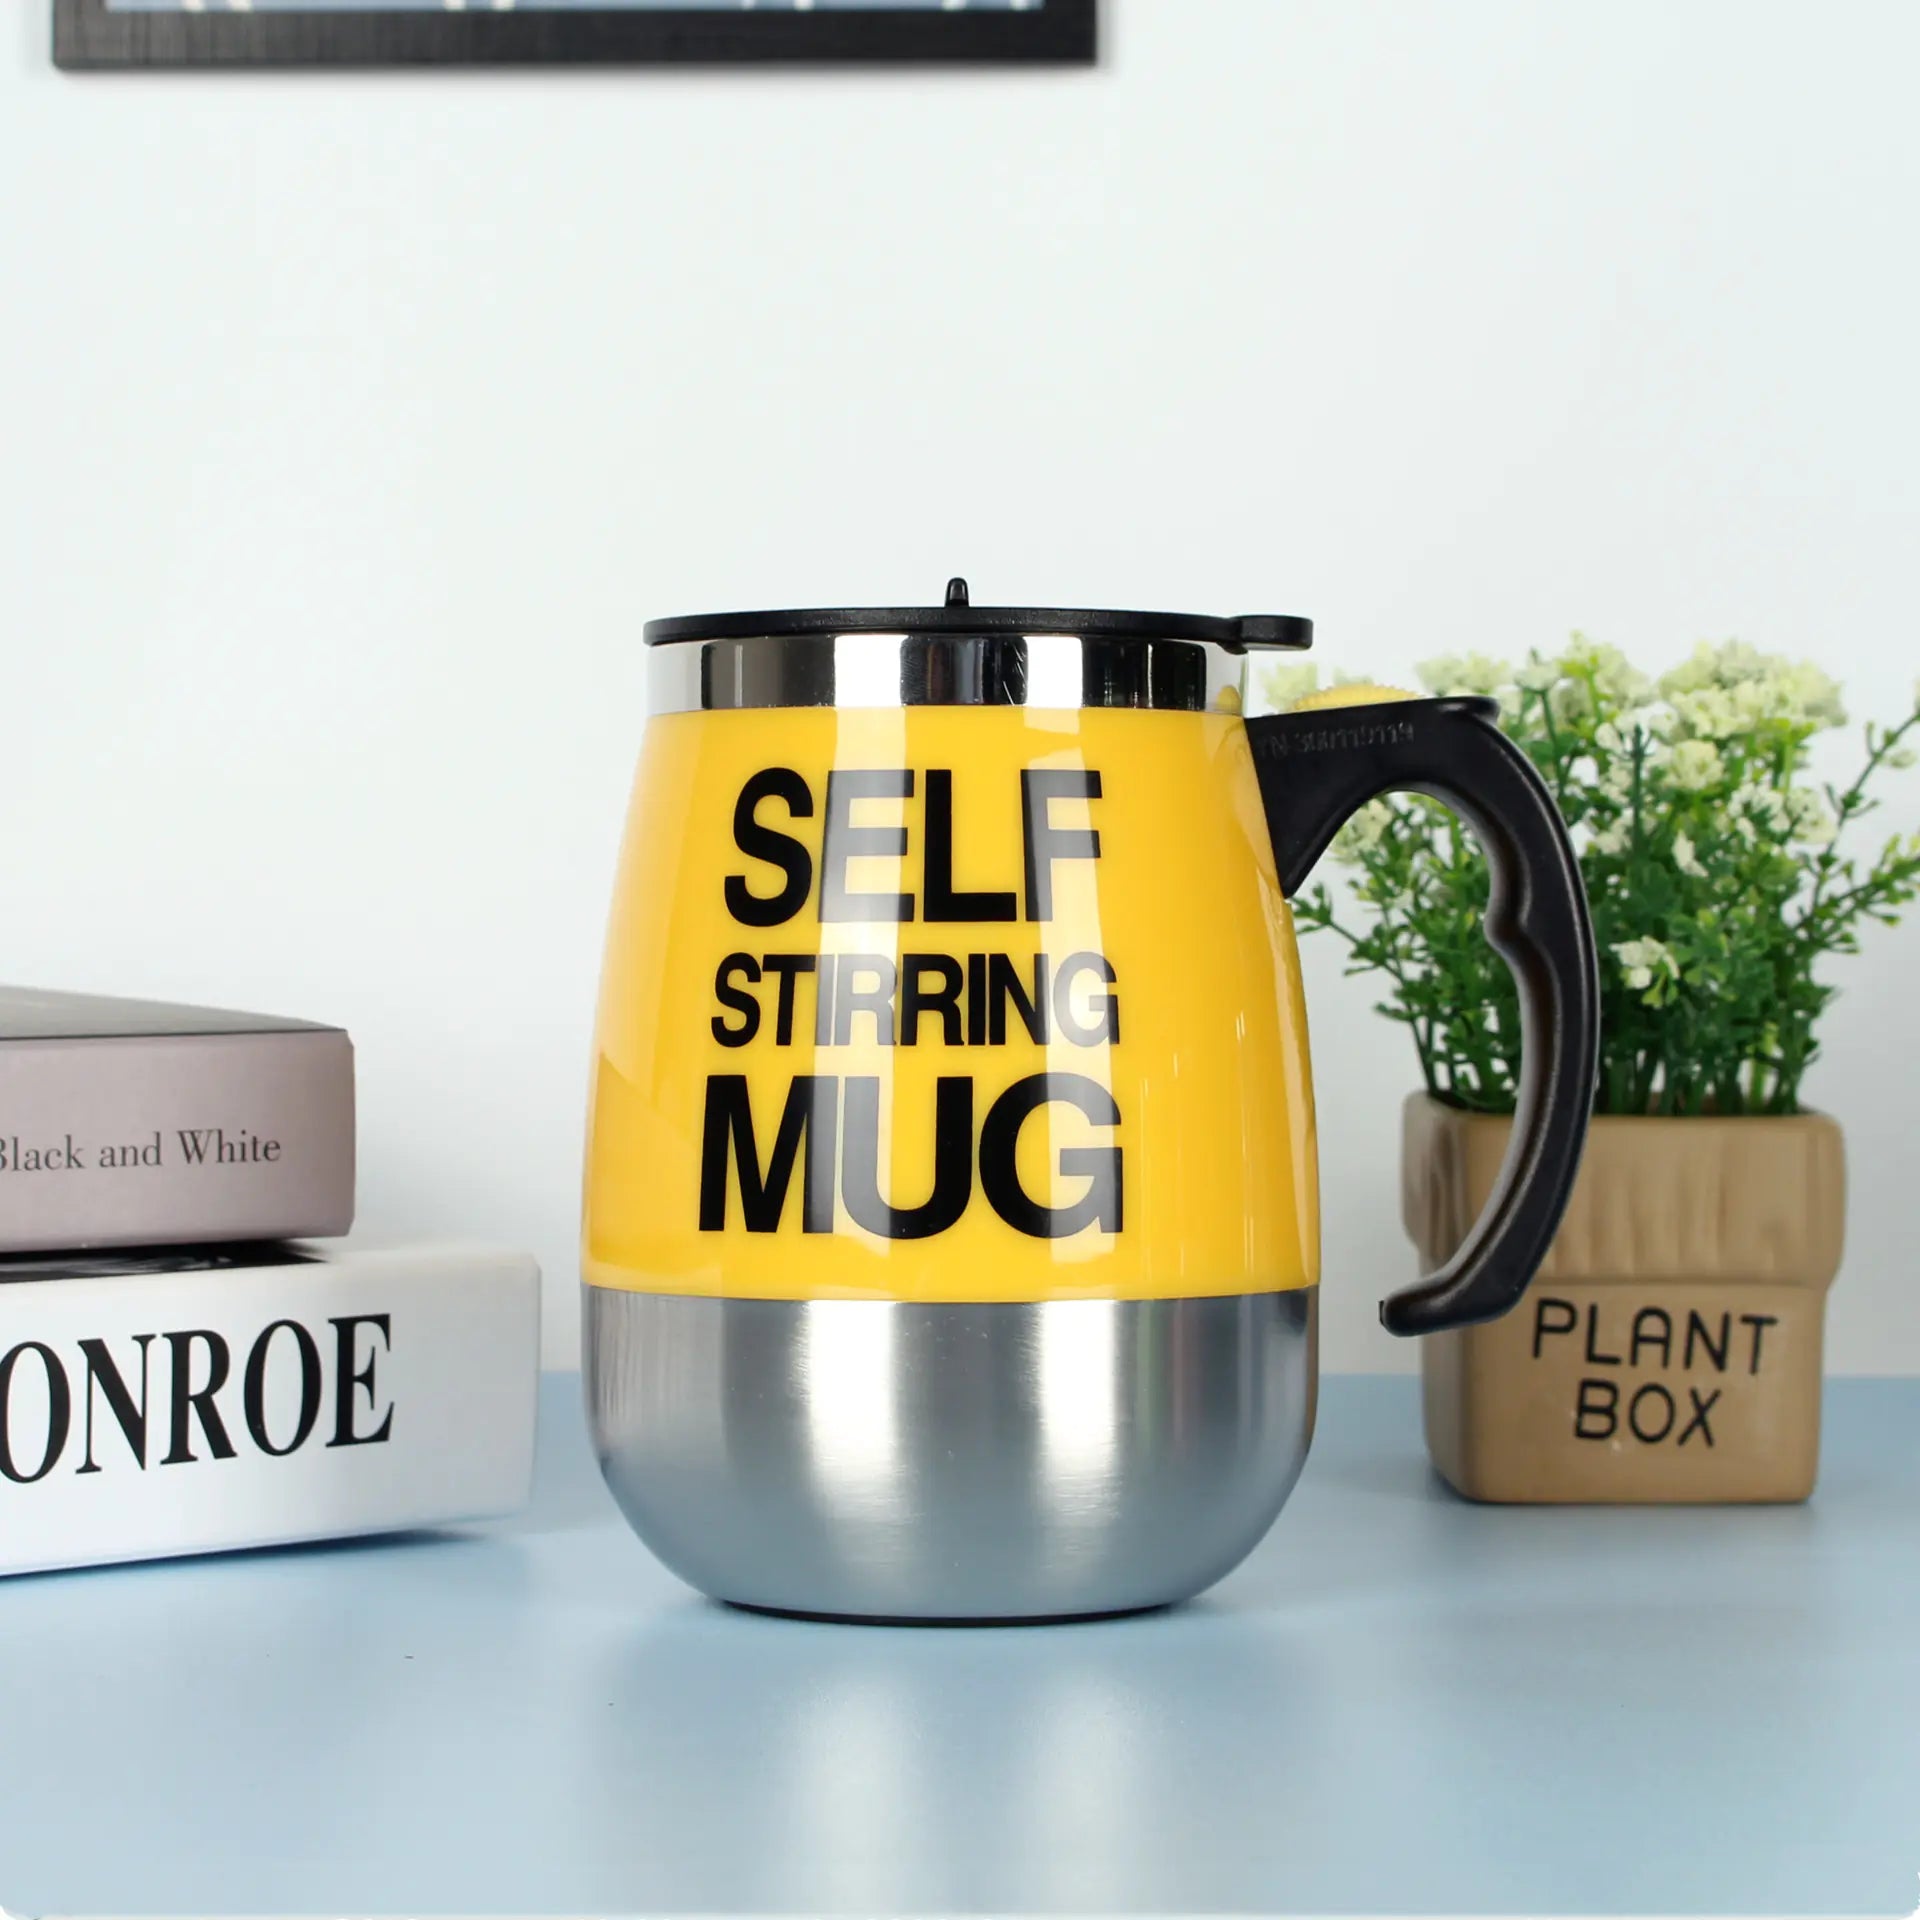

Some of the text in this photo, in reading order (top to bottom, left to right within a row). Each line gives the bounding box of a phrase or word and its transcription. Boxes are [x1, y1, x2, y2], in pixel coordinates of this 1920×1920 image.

[724, 767, 1103, 928] SELF
[711, 952, 1121, 1048] STIRRING
[99, 1132, 162, 1168] and
[178, 1128, 282, 1164] White
[699, 1072, 1124, 1240] MUG
[1532, 1297, 1778, 1375] PLANT
[1574, 1378, 1722, 1447] BOX
